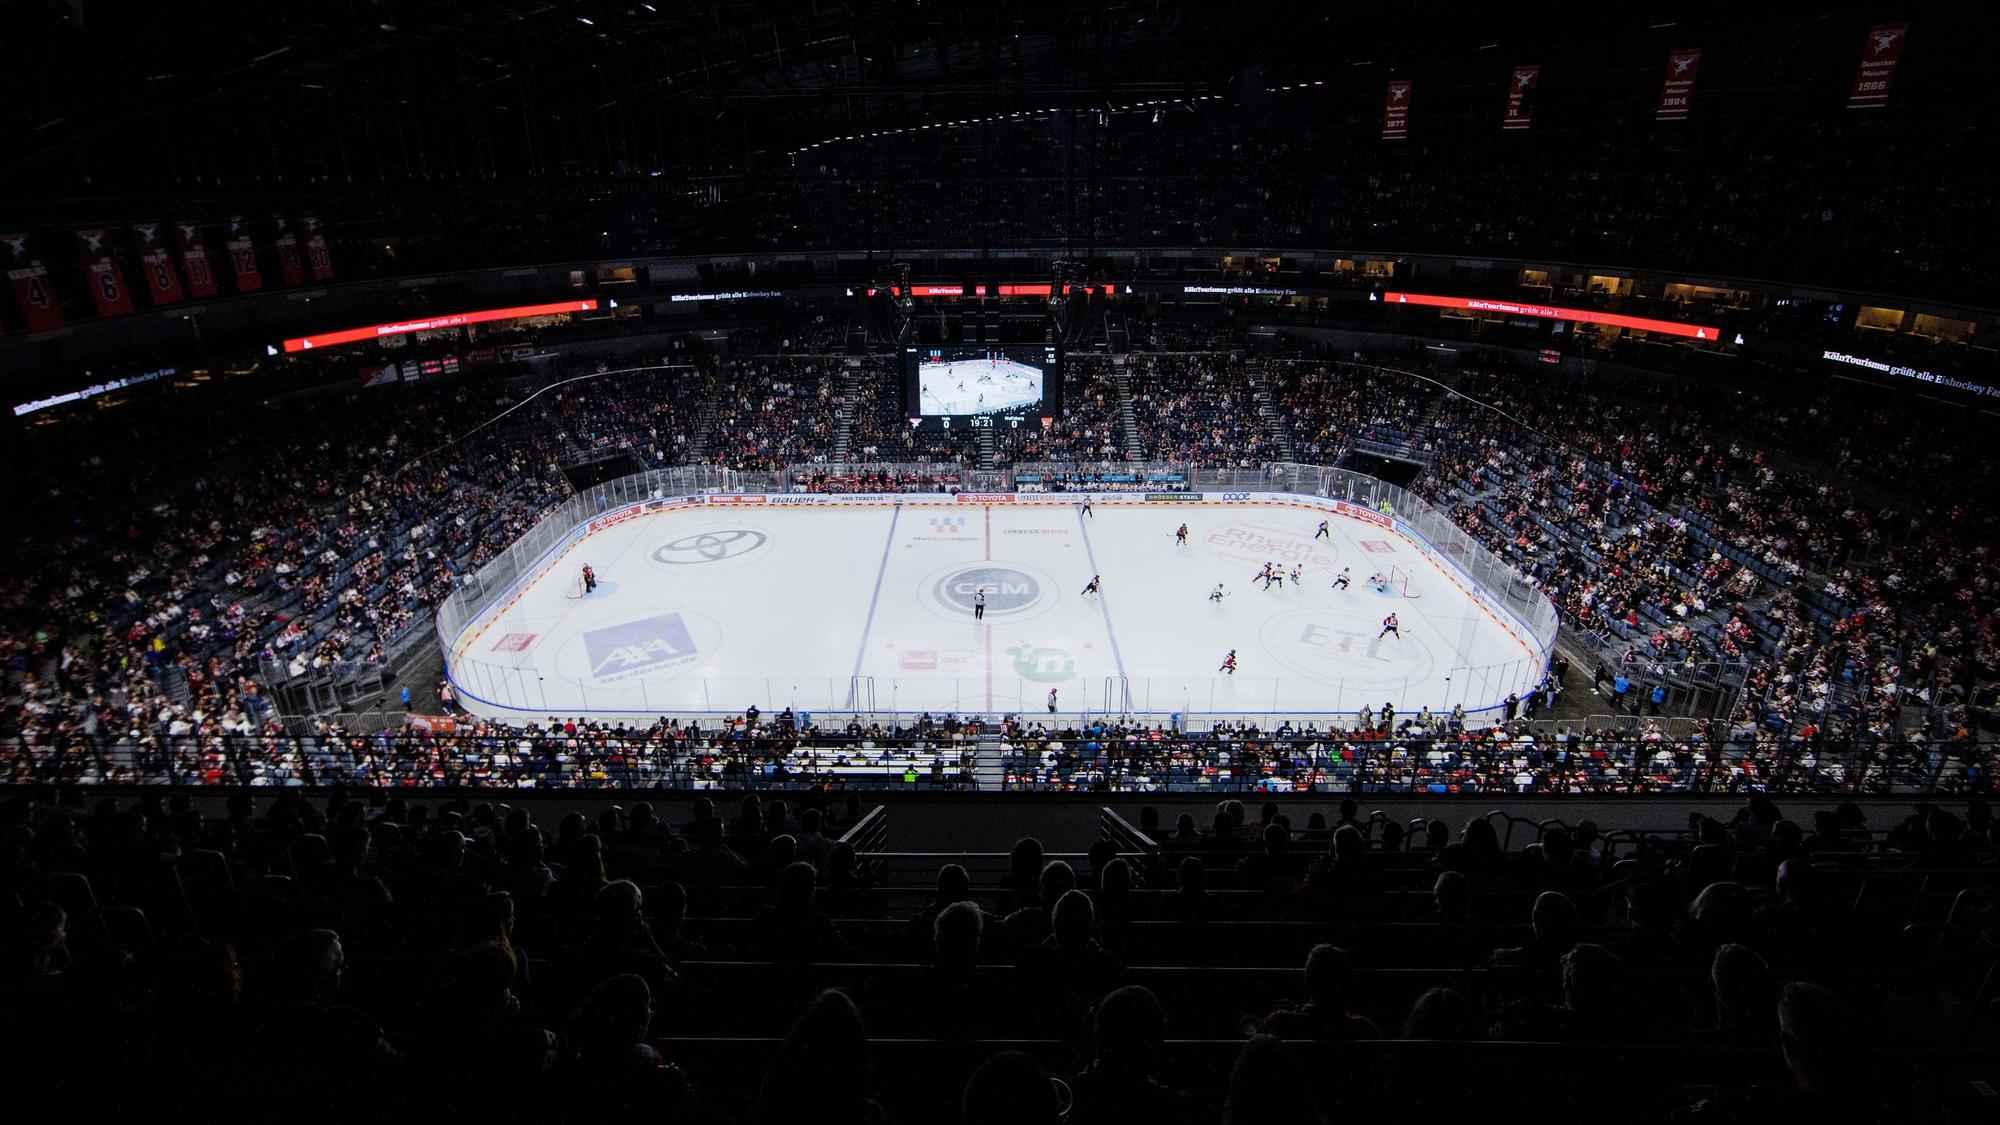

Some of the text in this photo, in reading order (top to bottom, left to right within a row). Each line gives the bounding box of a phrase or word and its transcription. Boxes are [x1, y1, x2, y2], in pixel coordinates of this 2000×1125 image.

[99, 273, 120, 301] 6
[1468, 300, 1519, 312] KölnTourismus
[1539, 308, 1552, 316] alle
[1823, 350, 1890, 372] KölnTourismus
[1889, 366, 1917, 378] grüßt
[1916, 371, 1935, 382] alle
[1934, 374, 1985, 396] Eishockey
[943, 420, 950, 429] 0
[970, 419, 994, 427] 19:21
[1011, 420, 1018, 429] 0
[606, 508, 634, 523] TOYOTA
[1358, 507, 1386, 523] TOYOTA
[954, 582, 1030, 595] CGM
[593, 638, 679, 674] AXA
